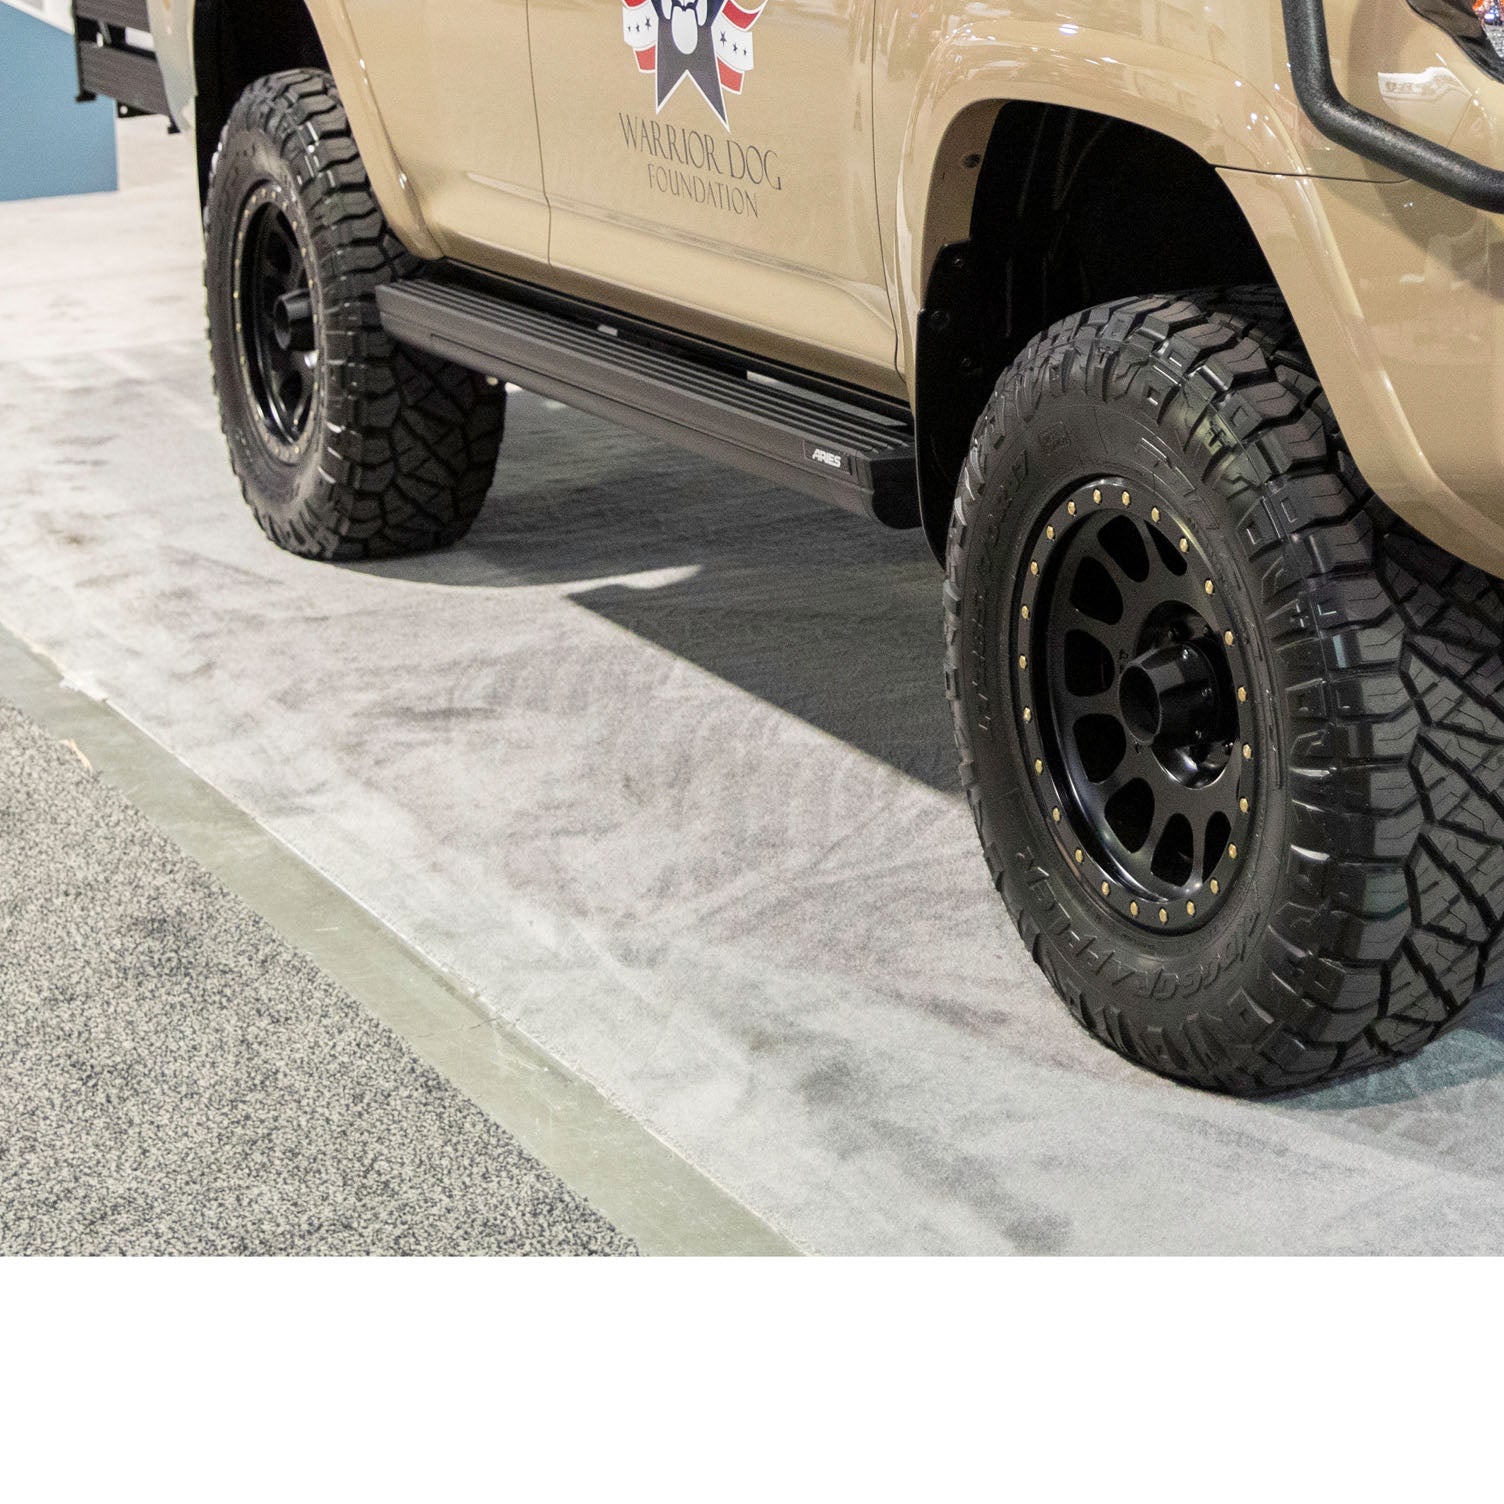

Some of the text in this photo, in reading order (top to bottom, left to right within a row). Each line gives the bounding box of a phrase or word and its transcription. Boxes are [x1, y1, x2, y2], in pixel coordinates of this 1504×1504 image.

[618, 112, 782, 191] WARRIOR DOG
[647, 163, 759, 218] FOUNDATION
[812, 448, 841, 468] ARIES
